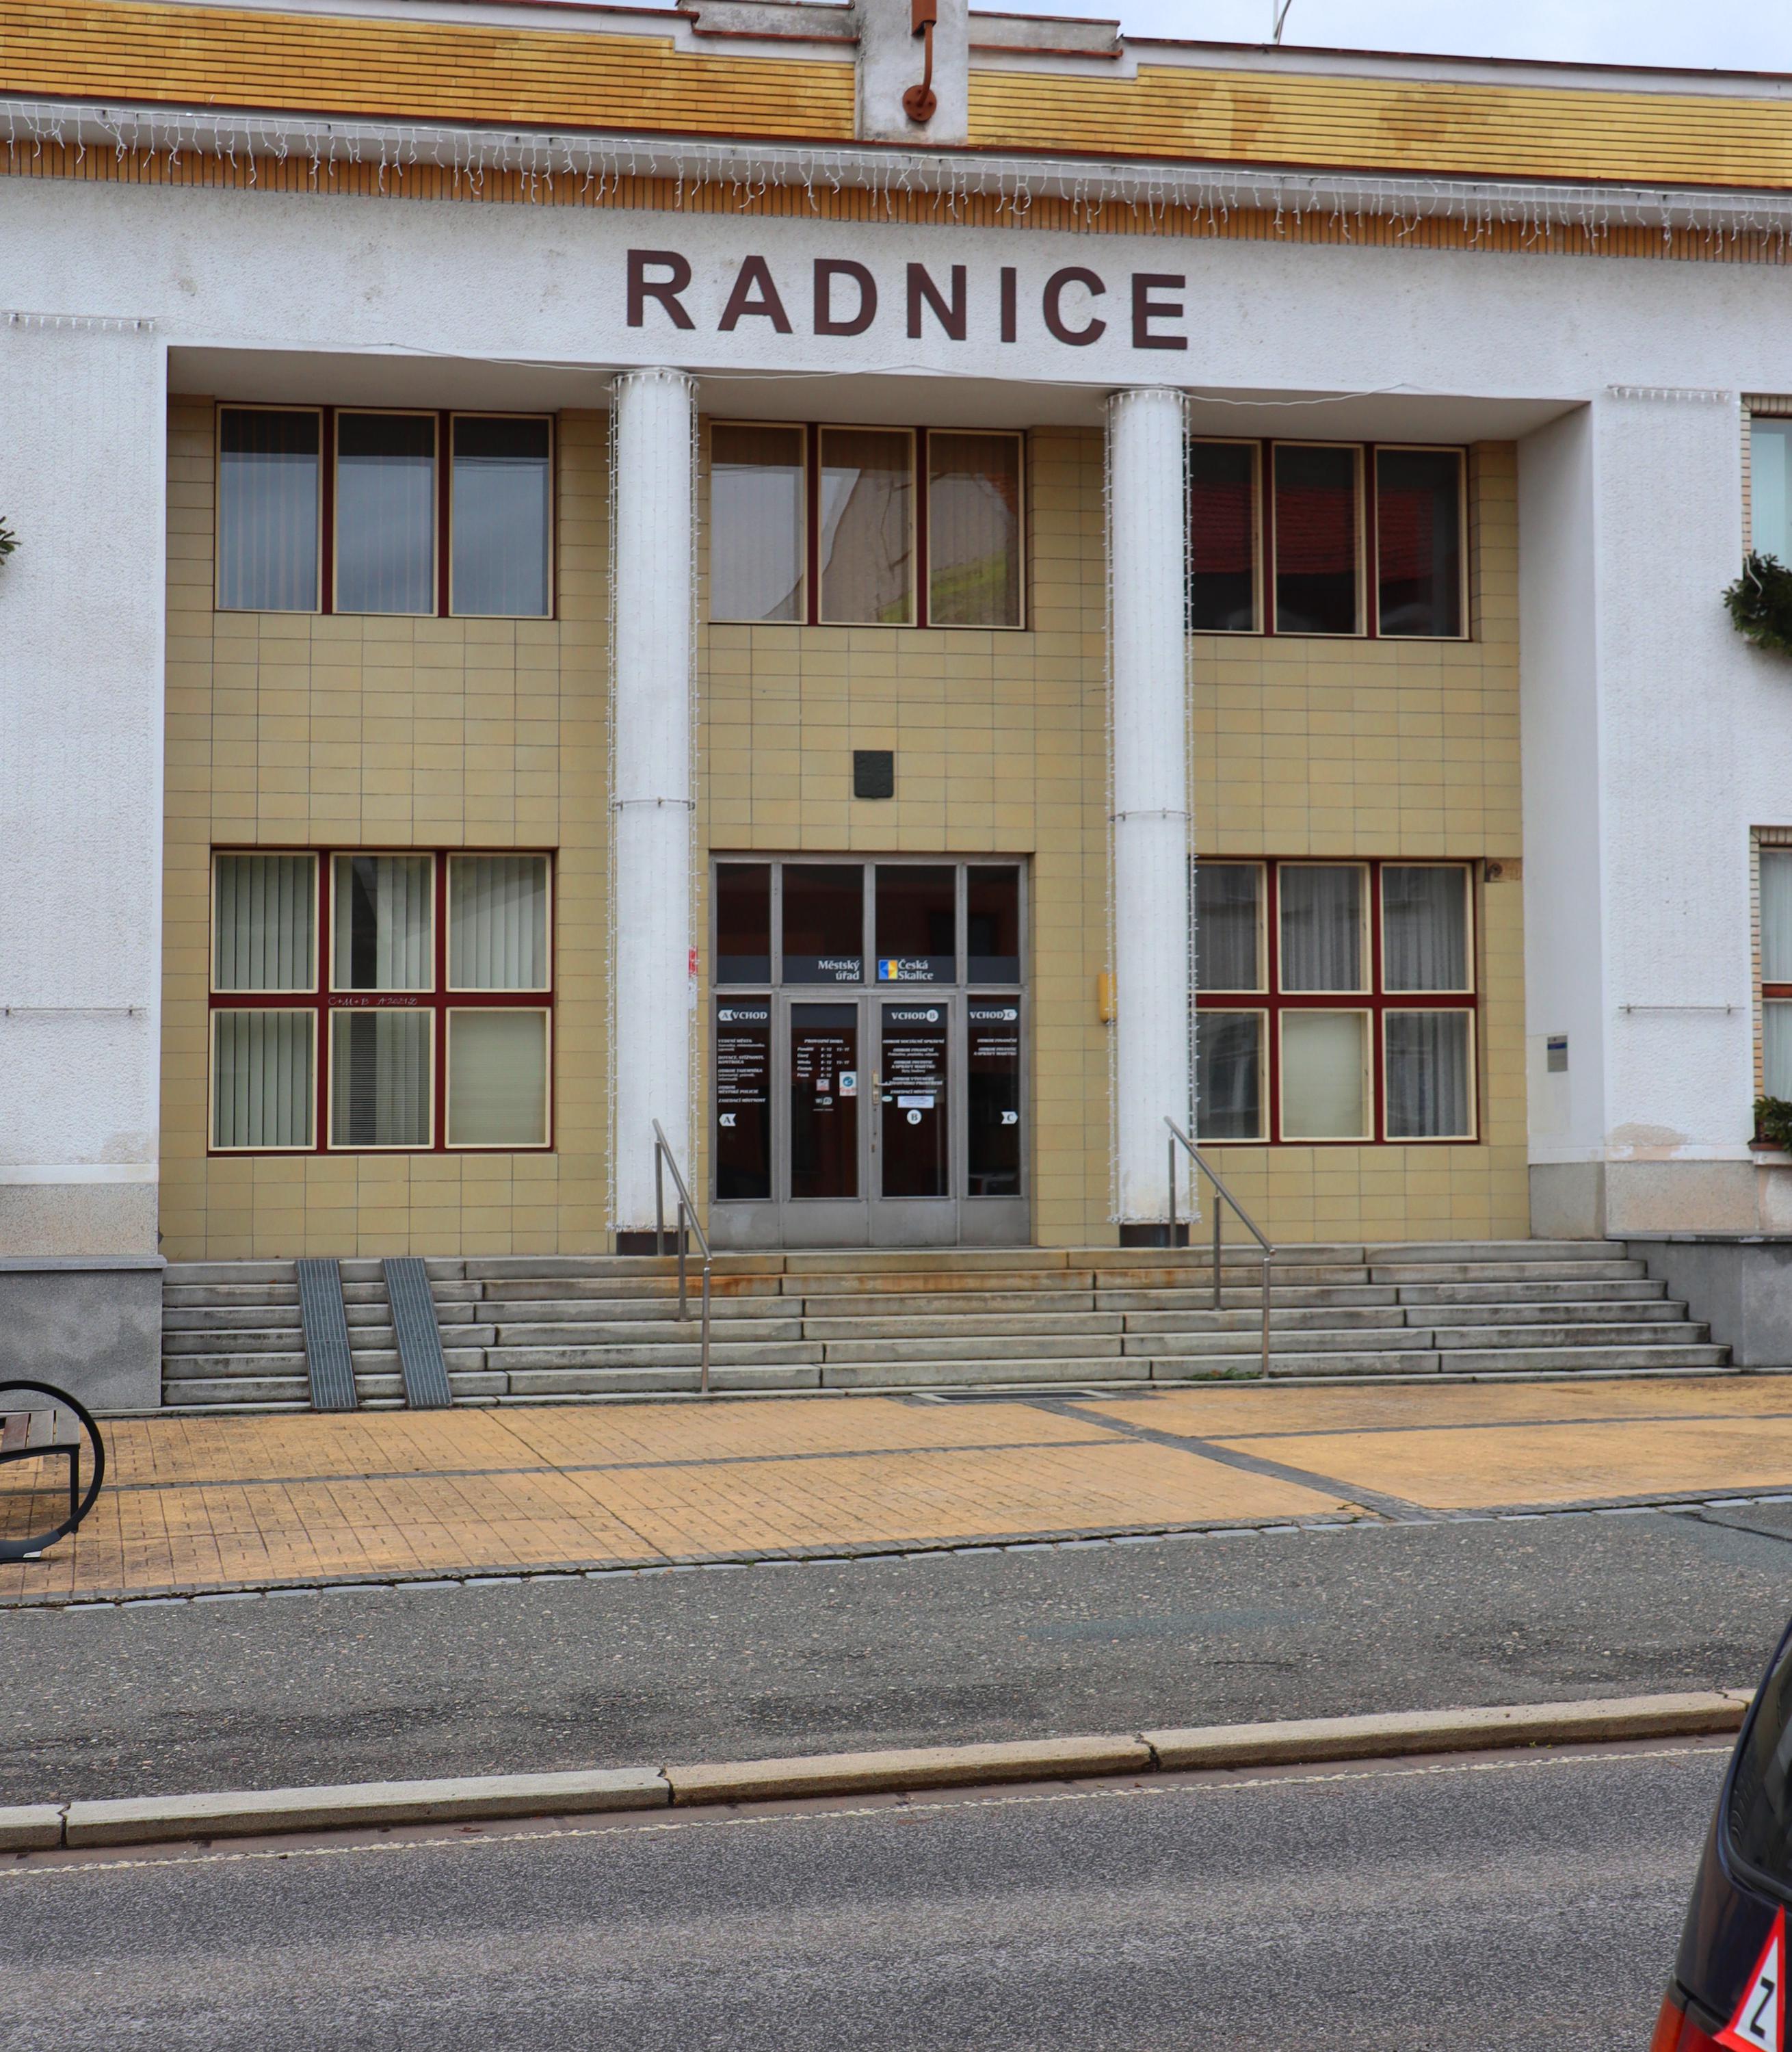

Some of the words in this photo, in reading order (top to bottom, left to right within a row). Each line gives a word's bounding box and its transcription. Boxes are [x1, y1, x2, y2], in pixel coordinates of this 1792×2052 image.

[627, 249, 1188, 350] RADNICE
[818, 960, 860, 971] Městský
[899, 959, 928, 969] Česká
[836, 971, 860, 980] úřad
[899, 971, 934, 980] Skalice
[1006, 1114, 1014, 1122] C
